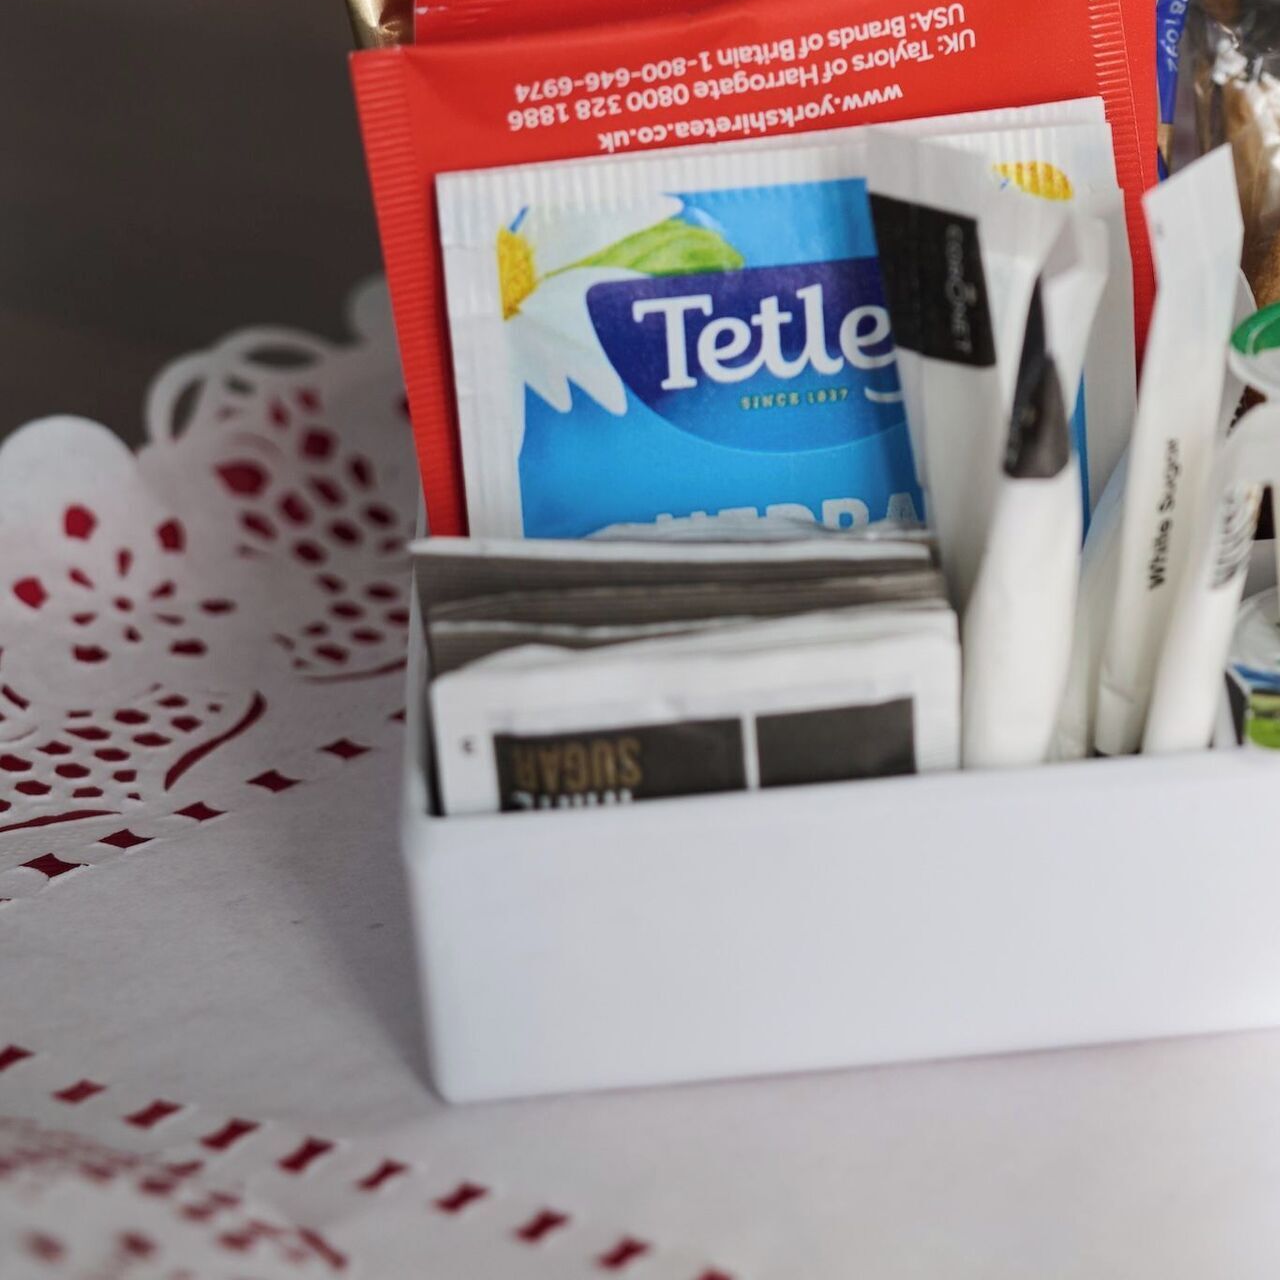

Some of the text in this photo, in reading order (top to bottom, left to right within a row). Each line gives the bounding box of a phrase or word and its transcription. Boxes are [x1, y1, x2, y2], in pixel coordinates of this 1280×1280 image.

[507, 28, 976, 132] UK: Taylors of Harrogate 0800 328 1886
[514, 2, 966, 104] USA: Brands of Britain 1-800-646-6974
[597, 83, 904, 154] www.yorkshiretea.co.uk
[632, 283, 904, 403] Tetle
[740, 391, 800, 411] SINCE
[511, 735, 643, 796] SUGAR
